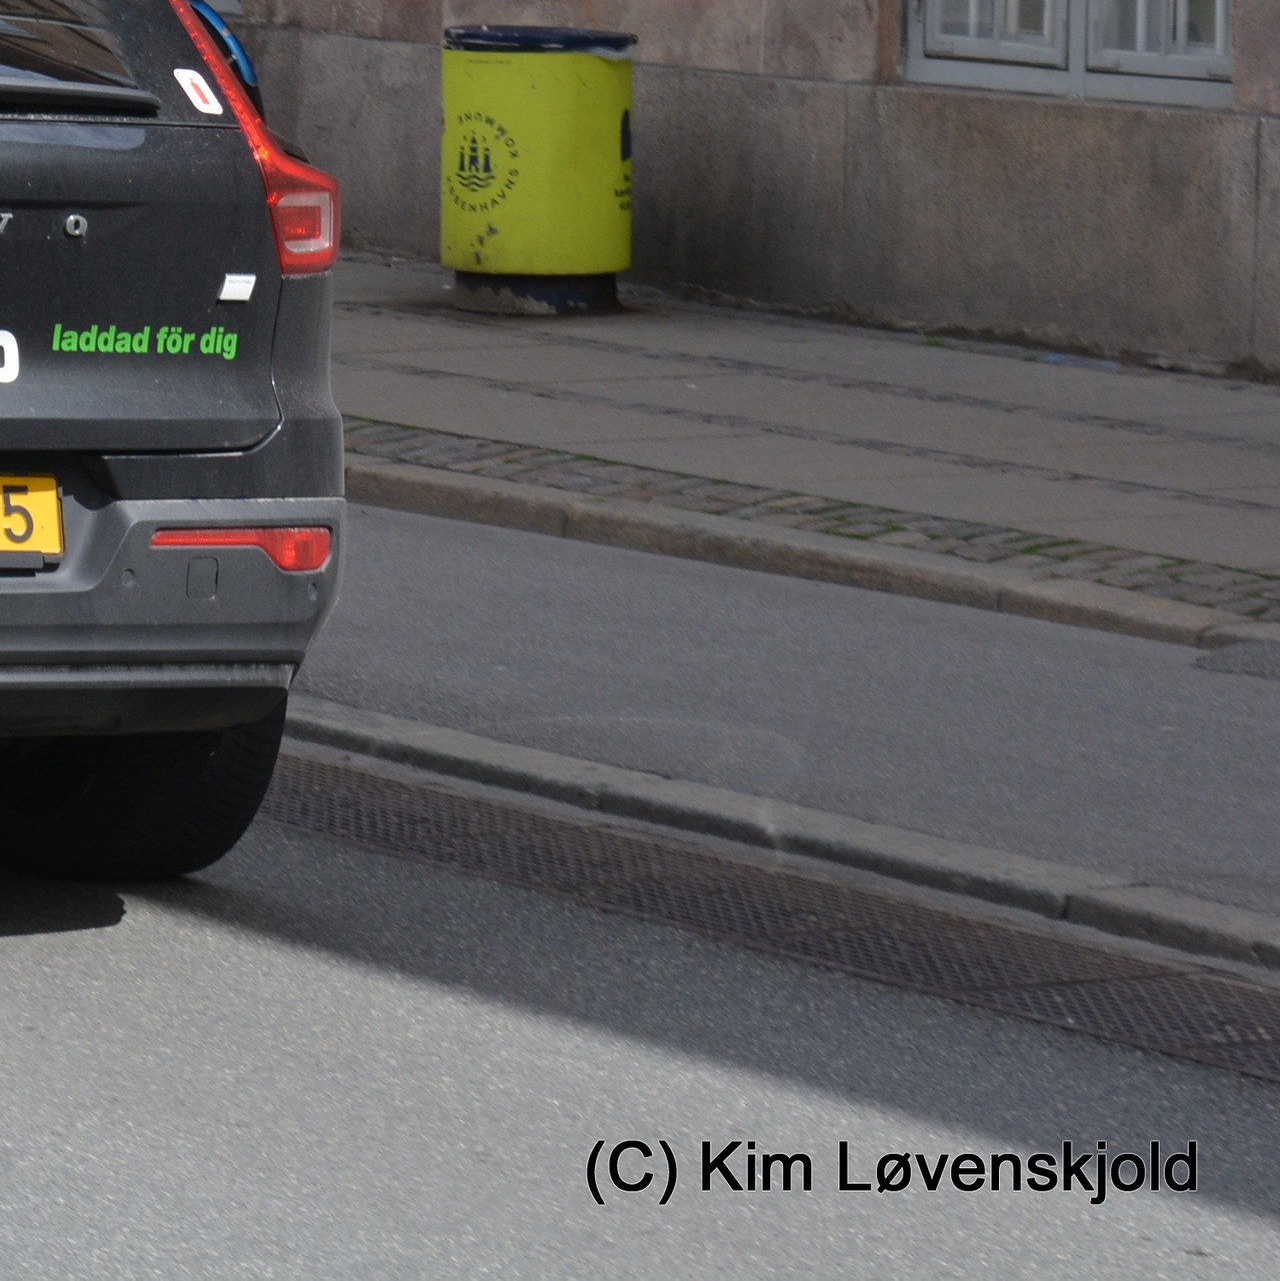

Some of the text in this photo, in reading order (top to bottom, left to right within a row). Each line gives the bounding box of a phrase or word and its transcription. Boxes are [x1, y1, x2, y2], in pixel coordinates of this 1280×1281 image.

[51, 322, 239, 362] laddad för dig
